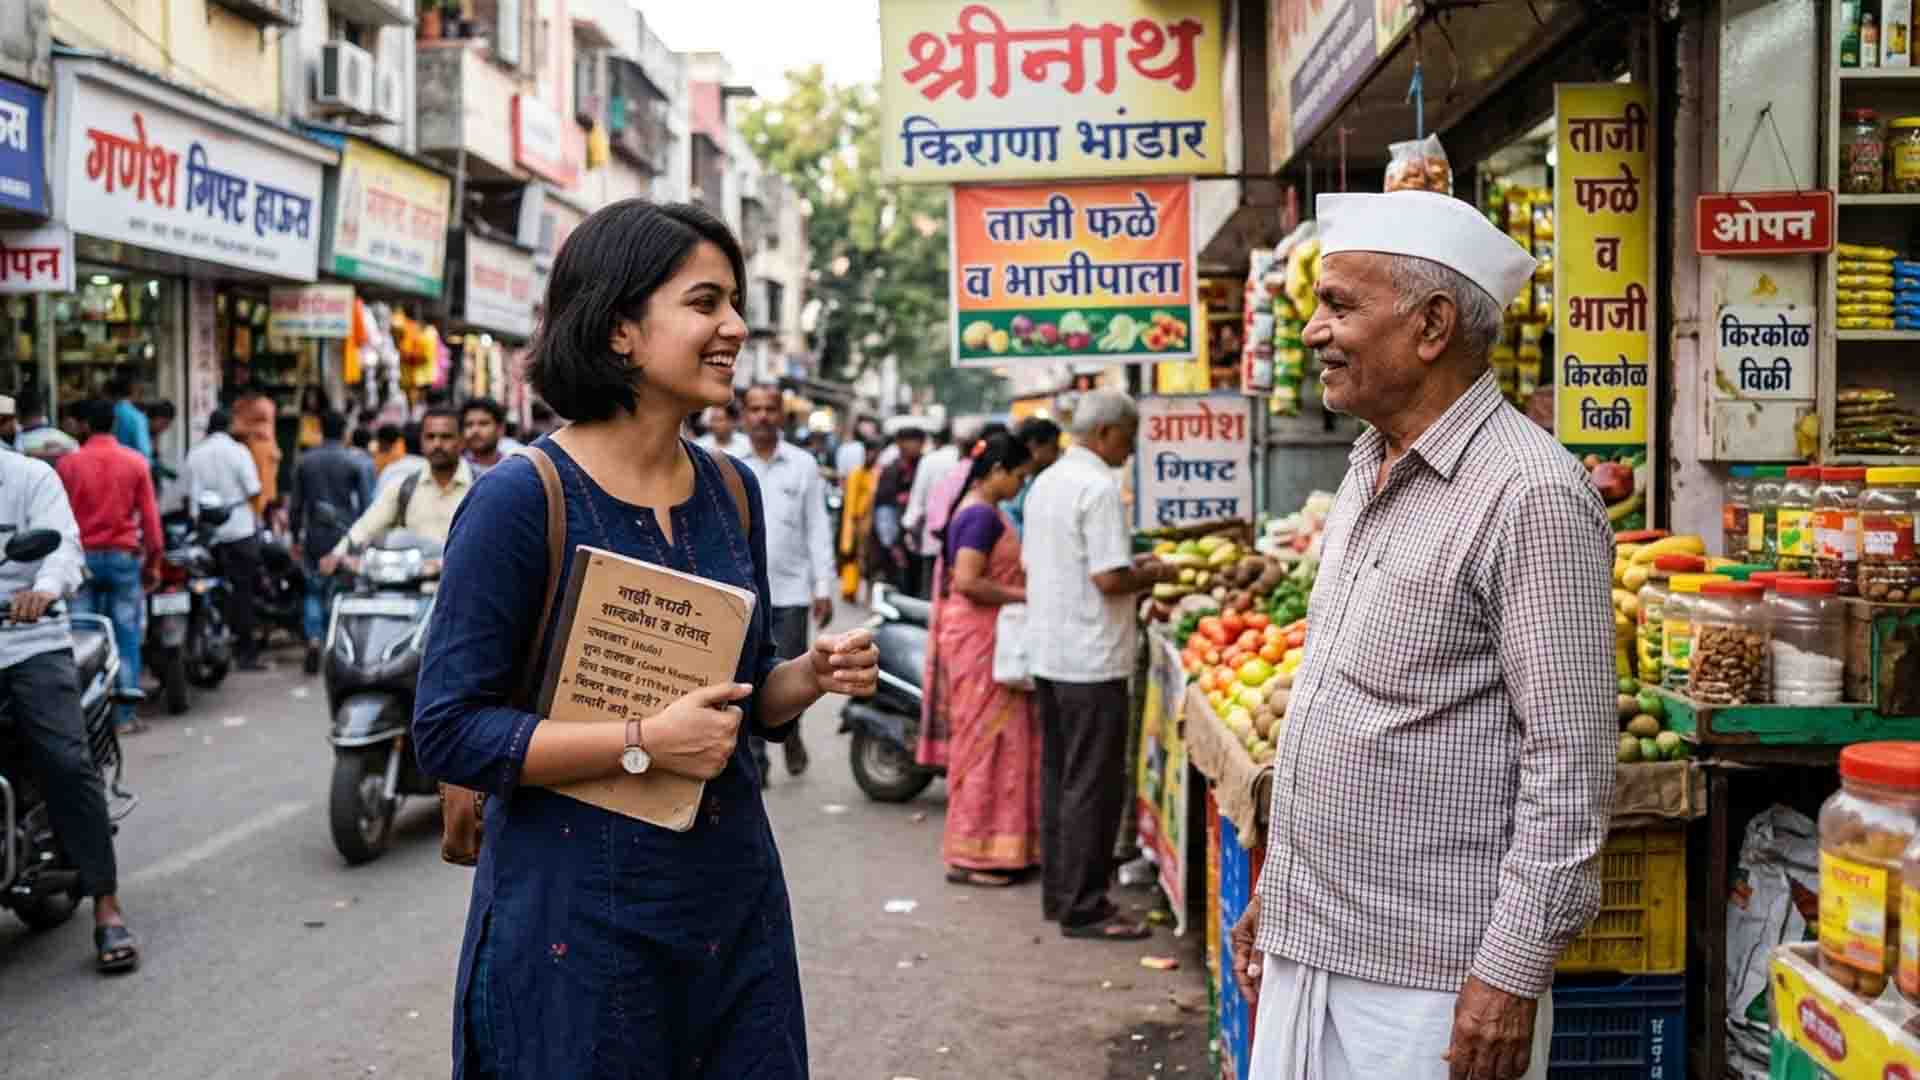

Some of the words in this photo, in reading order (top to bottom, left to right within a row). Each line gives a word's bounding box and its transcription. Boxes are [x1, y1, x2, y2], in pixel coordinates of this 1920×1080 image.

[901, 4, 1204, 101] श्रीनाथ
[900, 116, 1060, 168] किराणा
[1077, 108, 1206, 160] भांडार
[1568, 104, 1647, 153] ताजी
[85, 112, 180, 208] गणेश
[186, 140, 248, 223] गिफ्ट
[254, 184, 312, 240] हाऊस
[1575, 163, 1640, 214] फळे
[986, 195, 1073, 241] ताजी
[1087, 193, 1157, 239] फळे
[1712, 200, 1815, 243] ओपन
[965, 266, 992, 299] व
[1006, 252, 1182, 297] भाजीपाला
[1595, 237, 1620, 272] व
[1569, 283, 1647, 332] भाजी
[1721, 314, 1811, 348] किरकोळ
[1563, 354, 1647, 389] किरकोळ
[1740, 358, 1792, 391] विक्री
[1581, 398, 1630, 431] विक्री
[1155, 451, 1237, 481] गिफ्ट
[1157, 497, 1239, 526] हाऊस
